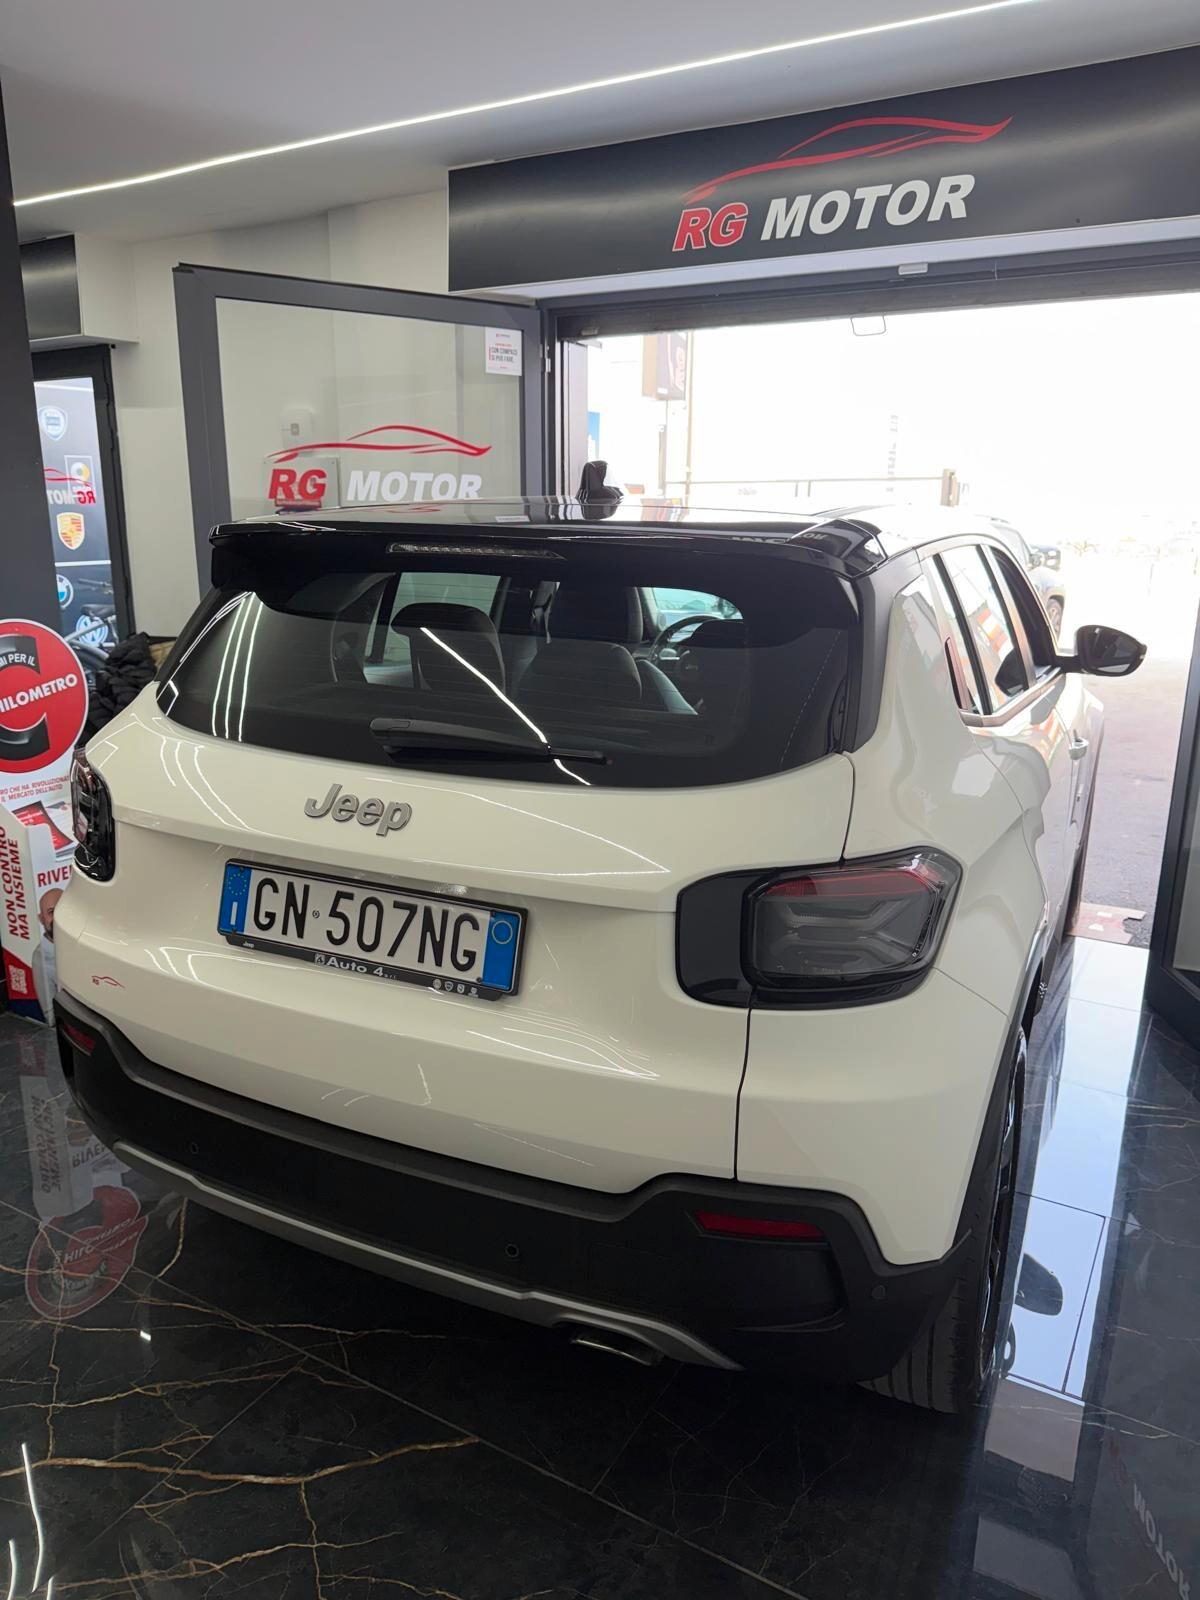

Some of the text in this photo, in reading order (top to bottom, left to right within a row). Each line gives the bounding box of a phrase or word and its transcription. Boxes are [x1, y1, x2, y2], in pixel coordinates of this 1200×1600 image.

[672, 174, 975, 252] RG MOTOR
[268, 468, 482, 501] RG MOTOR
[8, 653, 27, 664] PER
[28, 656, 36, 667] IL
[8, 789, 35, 801] MERCATO
[304, 783, 413, 837] Jeep
[8, 839, 30, 941] MA INSIEME
[6, 900, 19, 937] NON
[253, 877, 310, 939] GN
[326, 890, 480, 972] 507NG
[327, 956, 367, 973] Auto
[373, 966, 384, 977] 4
